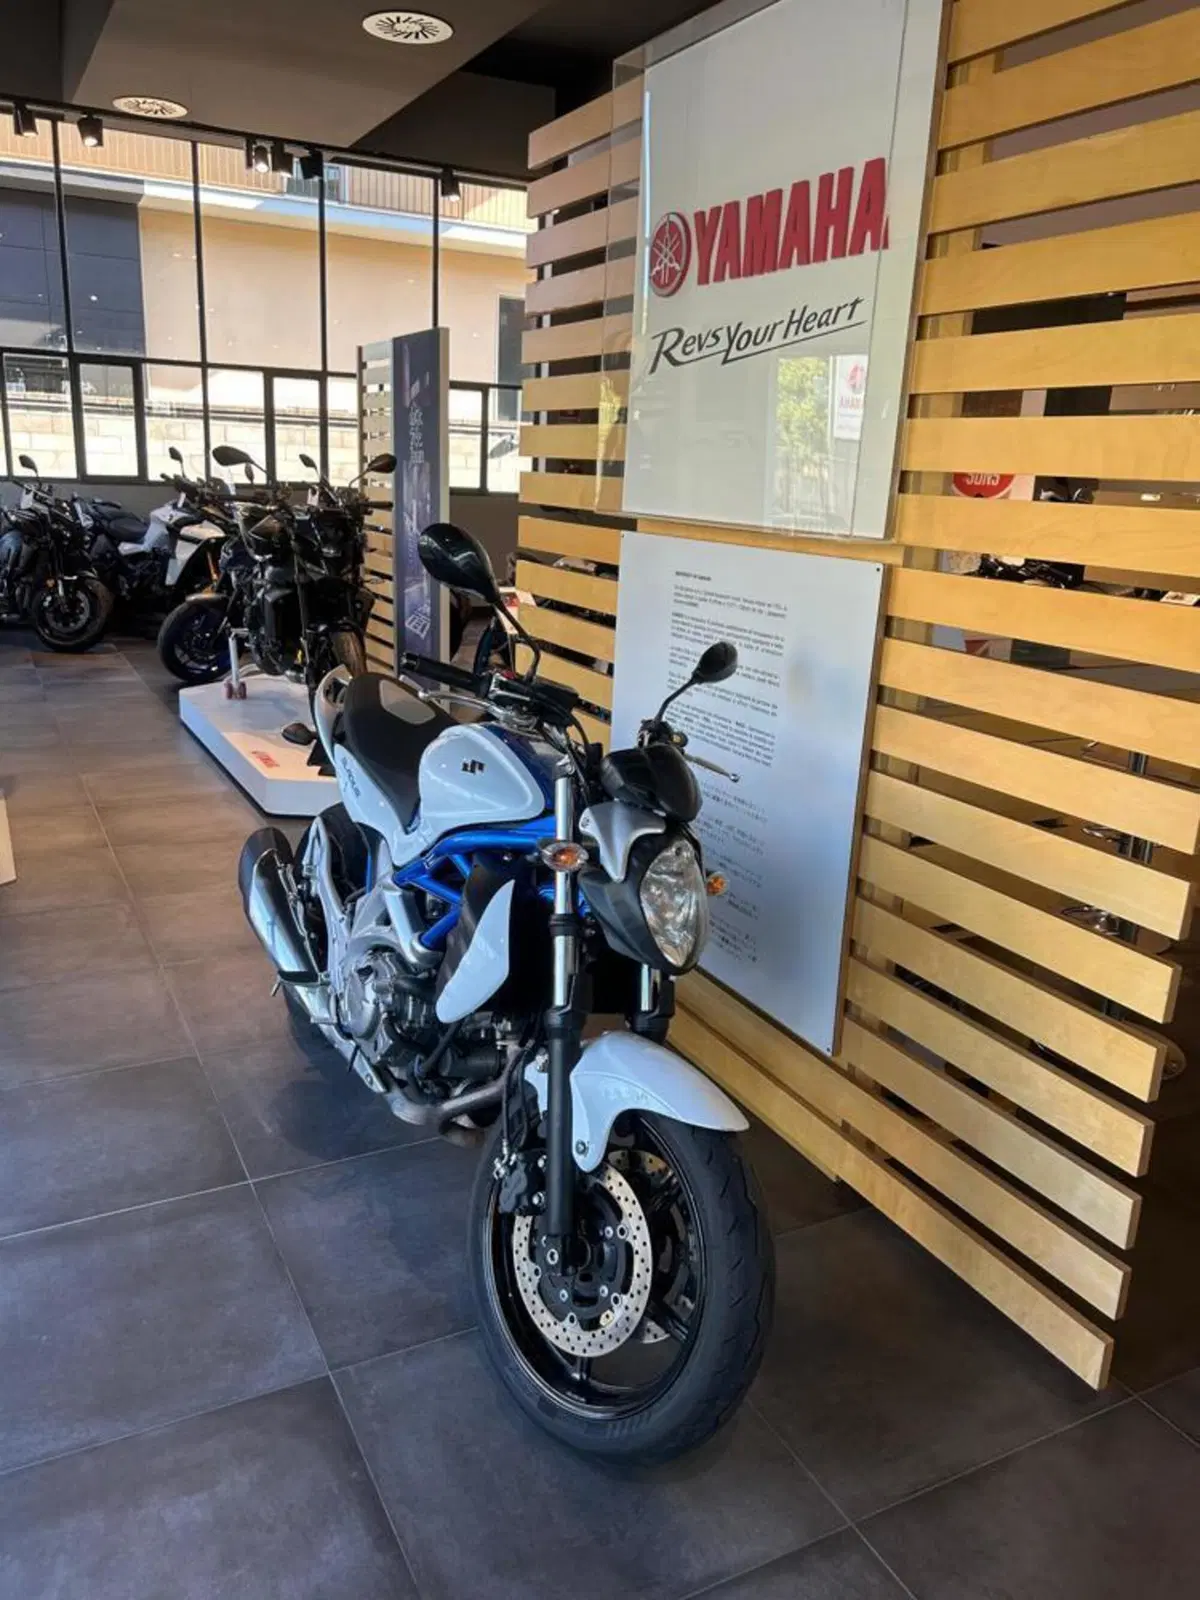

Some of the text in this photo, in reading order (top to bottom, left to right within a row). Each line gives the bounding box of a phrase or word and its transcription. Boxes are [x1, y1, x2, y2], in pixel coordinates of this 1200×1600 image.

[694, 157, 889, 286] YAMAHA
[649, 296, 865, 375] Revs Your Heart
